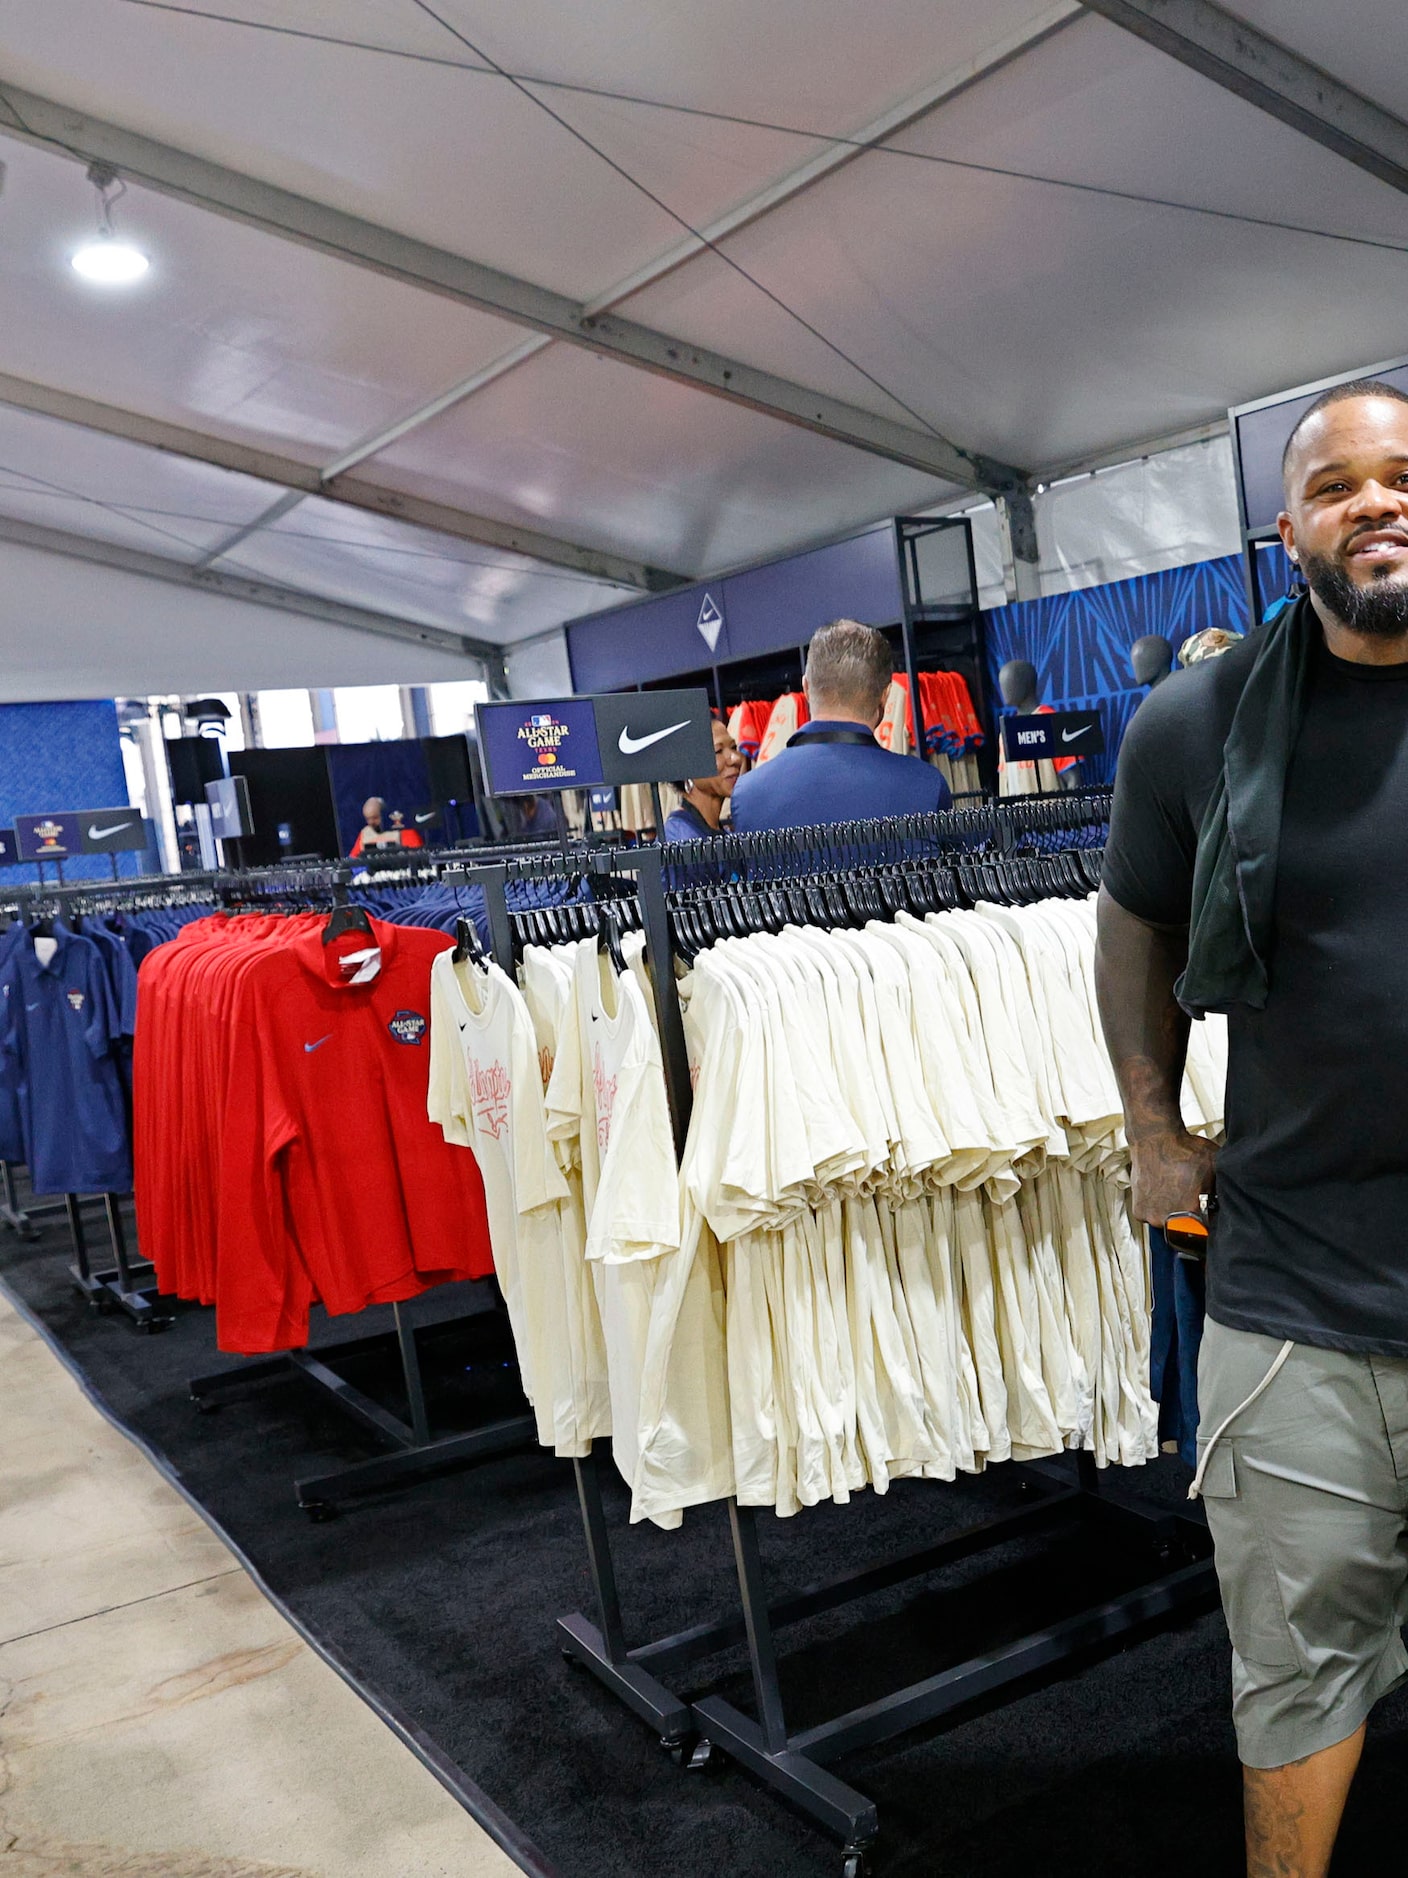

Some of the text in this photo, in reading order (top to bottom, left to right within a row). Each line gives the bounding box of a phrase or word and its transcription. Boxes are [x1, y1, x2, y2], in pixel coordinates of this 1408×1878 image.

[527, 736, 562, 748] GAME
[1017, 729, 1046, 745] MEN'S
[531, 765, 566, 774] OFFICIAL
